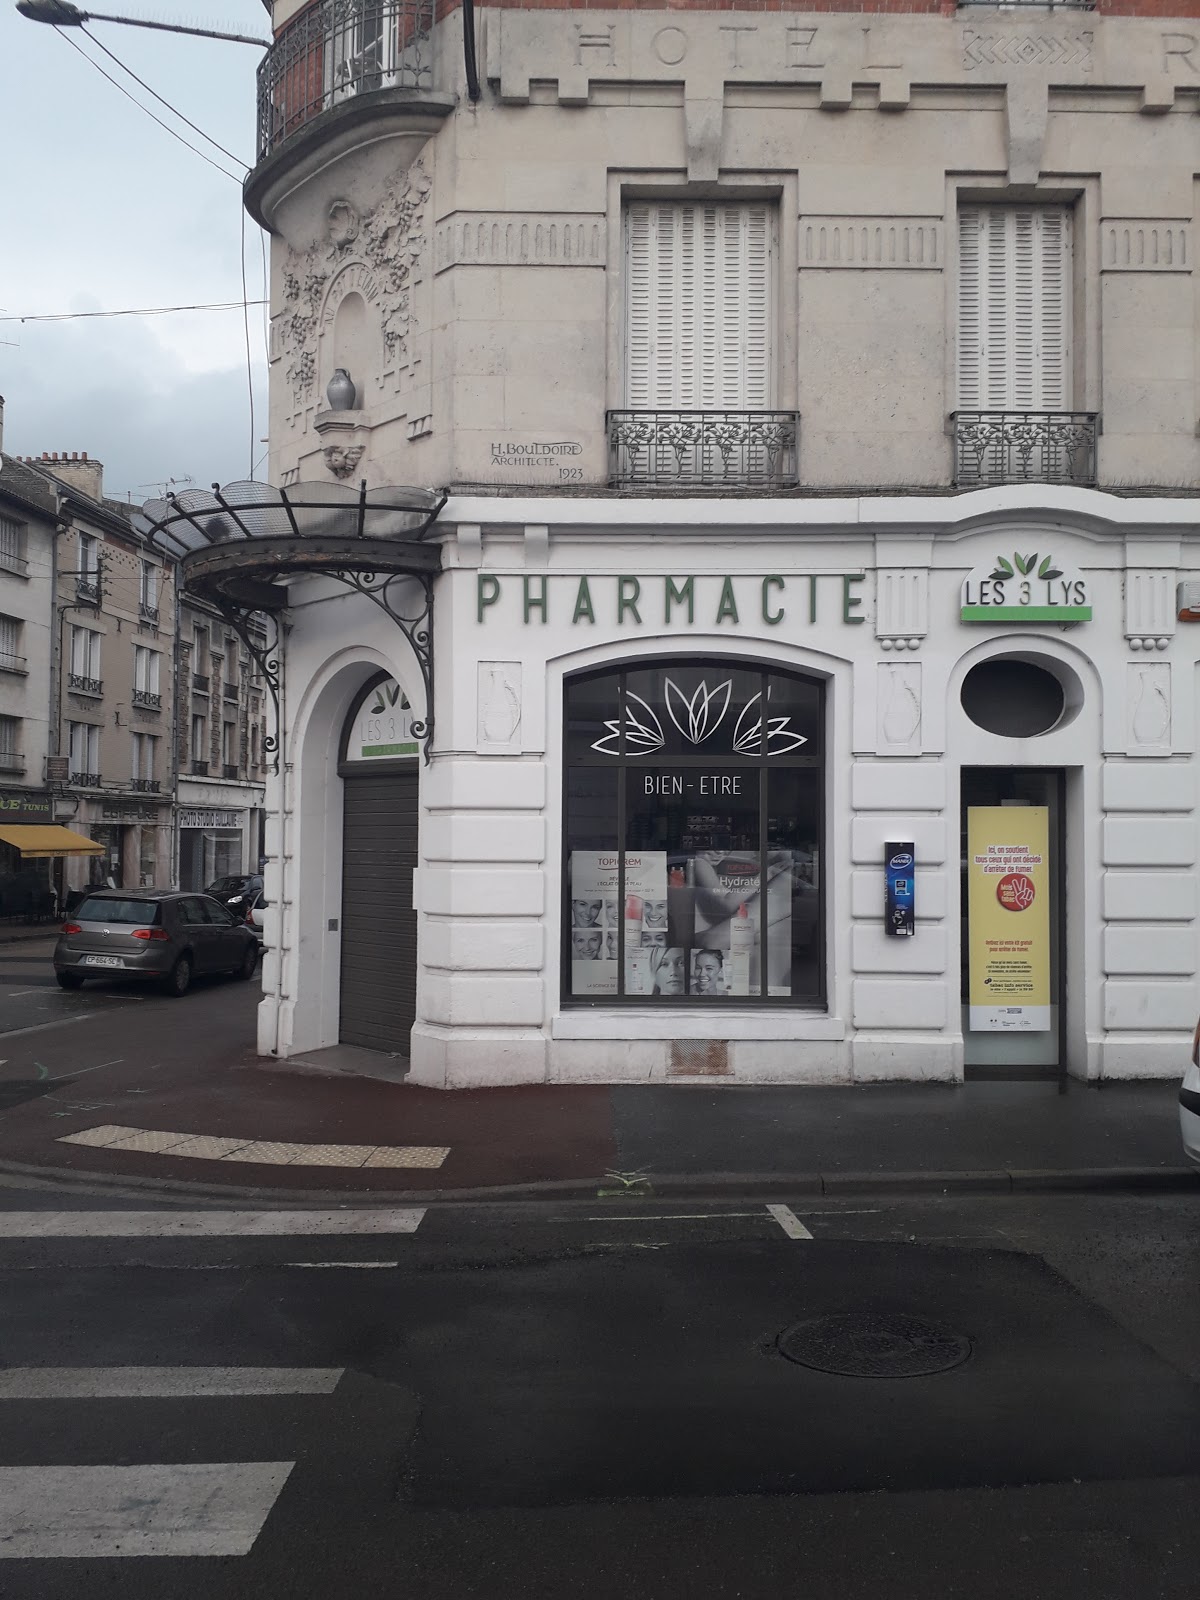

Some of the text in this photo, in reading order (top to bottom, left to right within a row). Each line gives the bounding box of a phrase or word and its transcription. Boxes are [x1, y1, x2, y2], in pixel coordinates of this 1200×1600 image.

[573, 24, 903, 69] HOTEL
[559, 468, 584, 480] 1923
[477, 574, 866, 624] PHARMACIE
[966, 580, 1087, 605] LES 3 LYS
[361, 719, 381, 741] LES
[388, 717, 396, 739] 3
[23, 803, 49, 811] TUNIS
[1022, 854, 1041, 863] décidé
